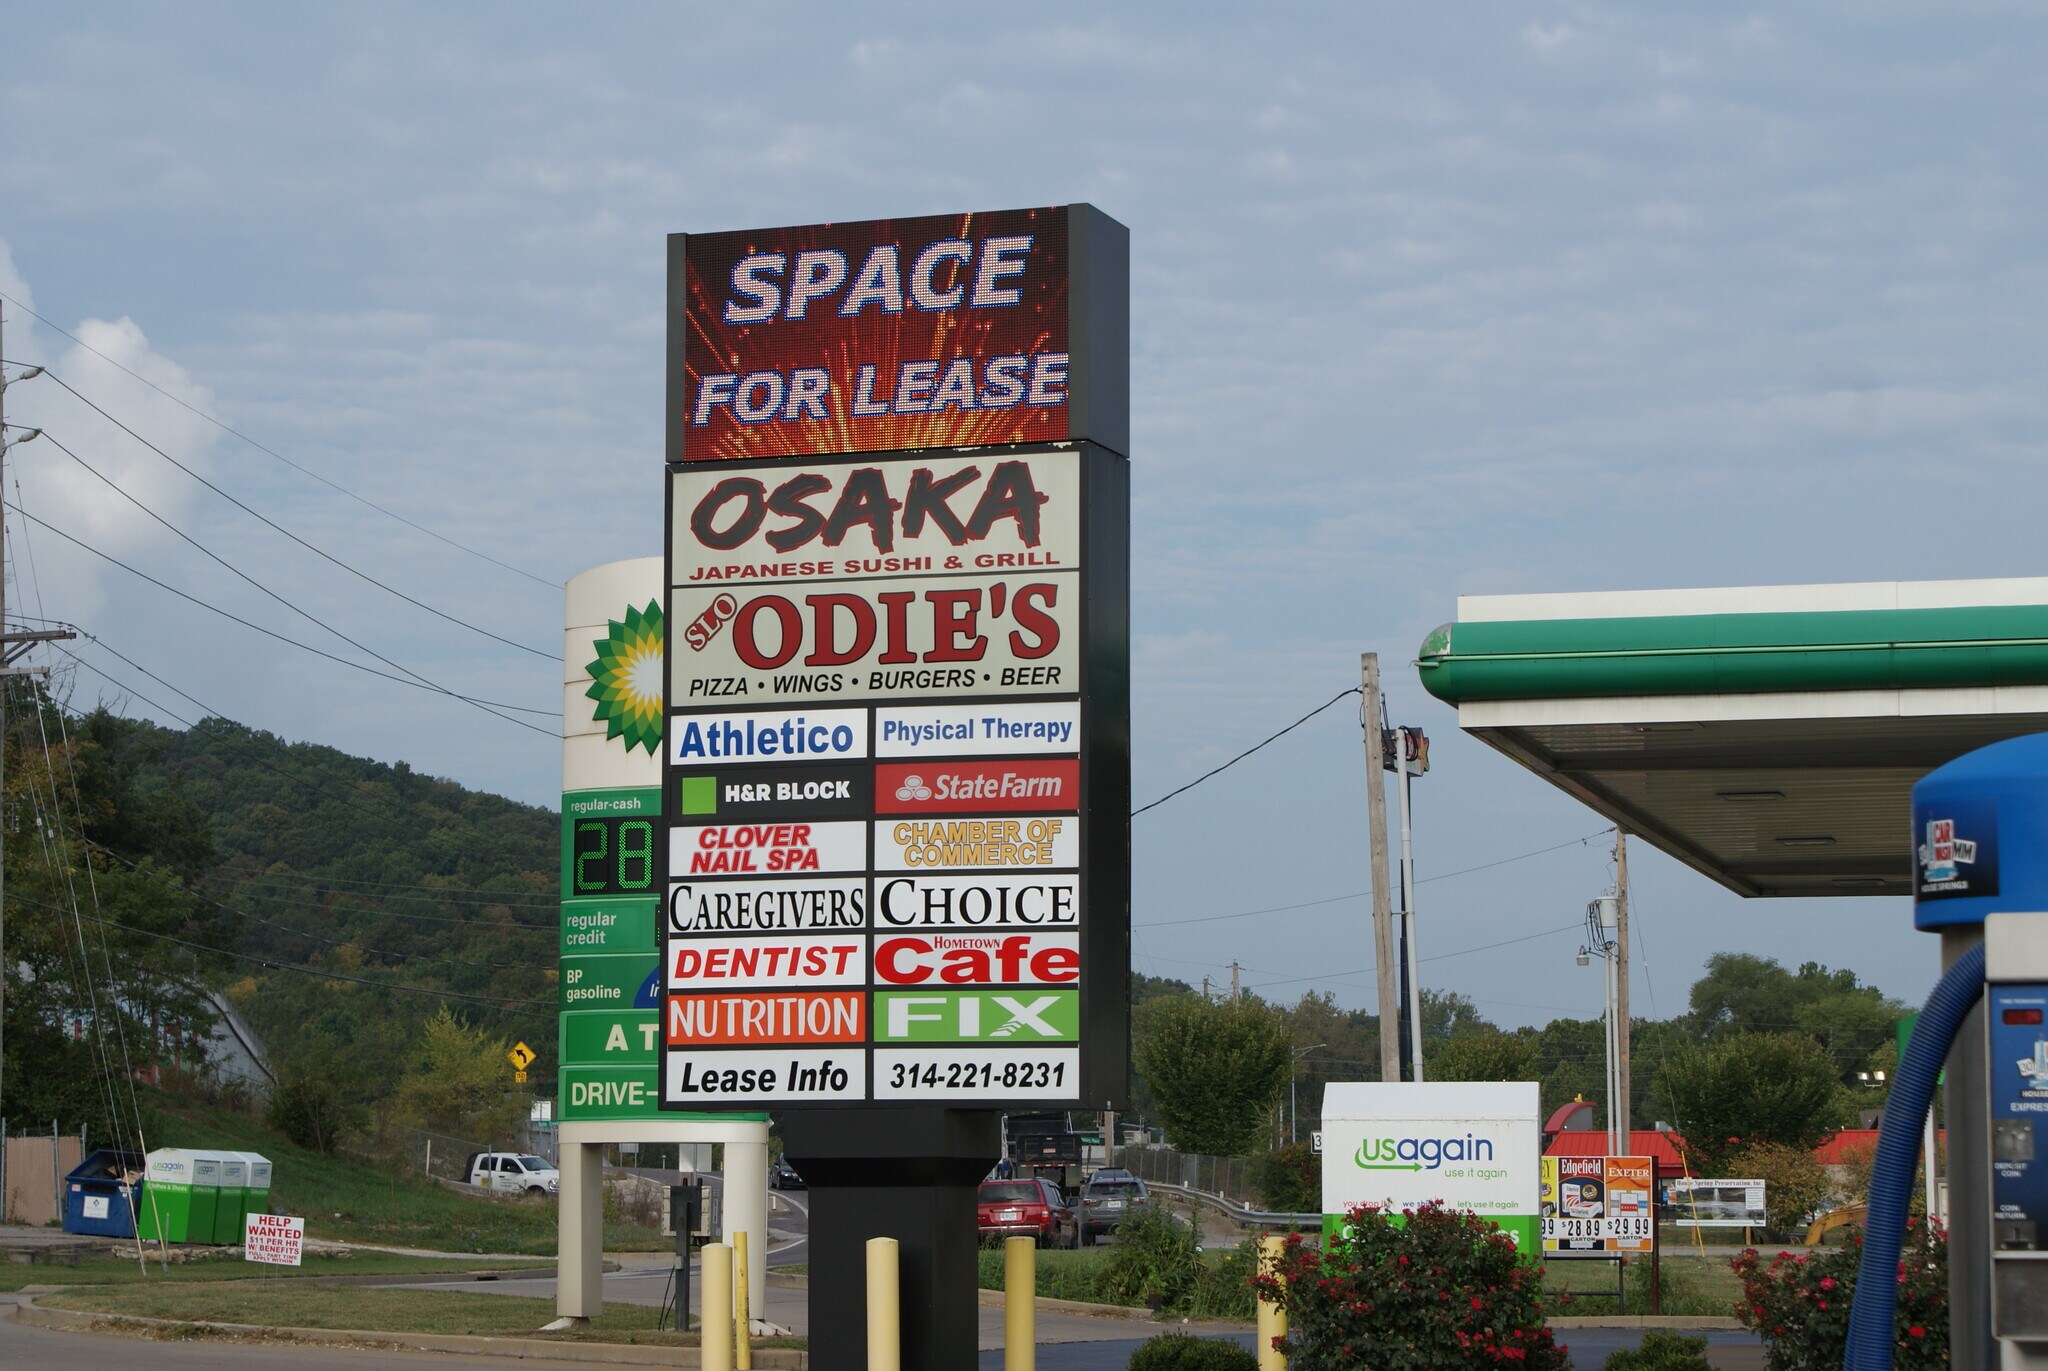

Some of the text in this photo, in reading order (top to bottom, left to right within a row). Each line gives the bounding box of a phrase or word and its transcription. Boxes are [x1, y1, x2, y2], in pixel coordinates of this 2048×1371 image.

[723, 235, 1034, 325] SPACE
[692, 352, 1069, 427] FOR LEASE
[690, 461, 1049, 554] OSAKA
[689, 551, 1060, 581] JAPANESE SUSHI & GRILL
[684, 593, 737, 652] SLO
[732, 582, 1060, 670] ODIE'S
[689, 666, 1061, 697] PIZZA WINGS BURGERS BEER
[679, 717, 854, 758] Athletico
[883, 717, 1073, 746] Physical Therapy
[725, 780, 850, 802] H&R BLOCK
[570, 798, 641, 814] regular-cash
[698, 824, 811, 849] CLOVER
[893, 820, 1062, 846] CHAMBER OF
[690, 847, 819, 874] NAIL SPA
[904, 842, 1052, 867] COMMERCE
[670, 885, 864, 931] CAREGIVERS
[880, 879, 1076, 926] CHOICE
[567, 912, 617, 928] regular
[566, 929, 606, 945] credit
[674, 945, 857, 979] DENTIST
[874, 936, 1079, 984] Cafe
[566, 969, 583, 984] BP
[566, 985, 621, 1002] gasoline
[670, 997, 858, 1038] NUTRITION
[888, 996, 1063, 1037] FIX
[681, 1060, 848, 1093] Lease Info
[890, 1062, 1065, 1089] 314-221-8231
[1362, 1133, 1493, 1169] usagain
[1444, 1168, 1507, 1180] use it again
[1561, 1159, 1601, 1176] Edgefield
[1608, 1167, 1649, 1177] EXETER
[1457, 1200, 1473, 1208] let's
[1495, 1201, 1518, 1209] again
[248, 1225, 301, 1239] WANTED
[259, 1216, 291, 1227] HELP
[260, 1245, 299, 1255] BENEFITS
[267, 1238, 283, 1246] PER
